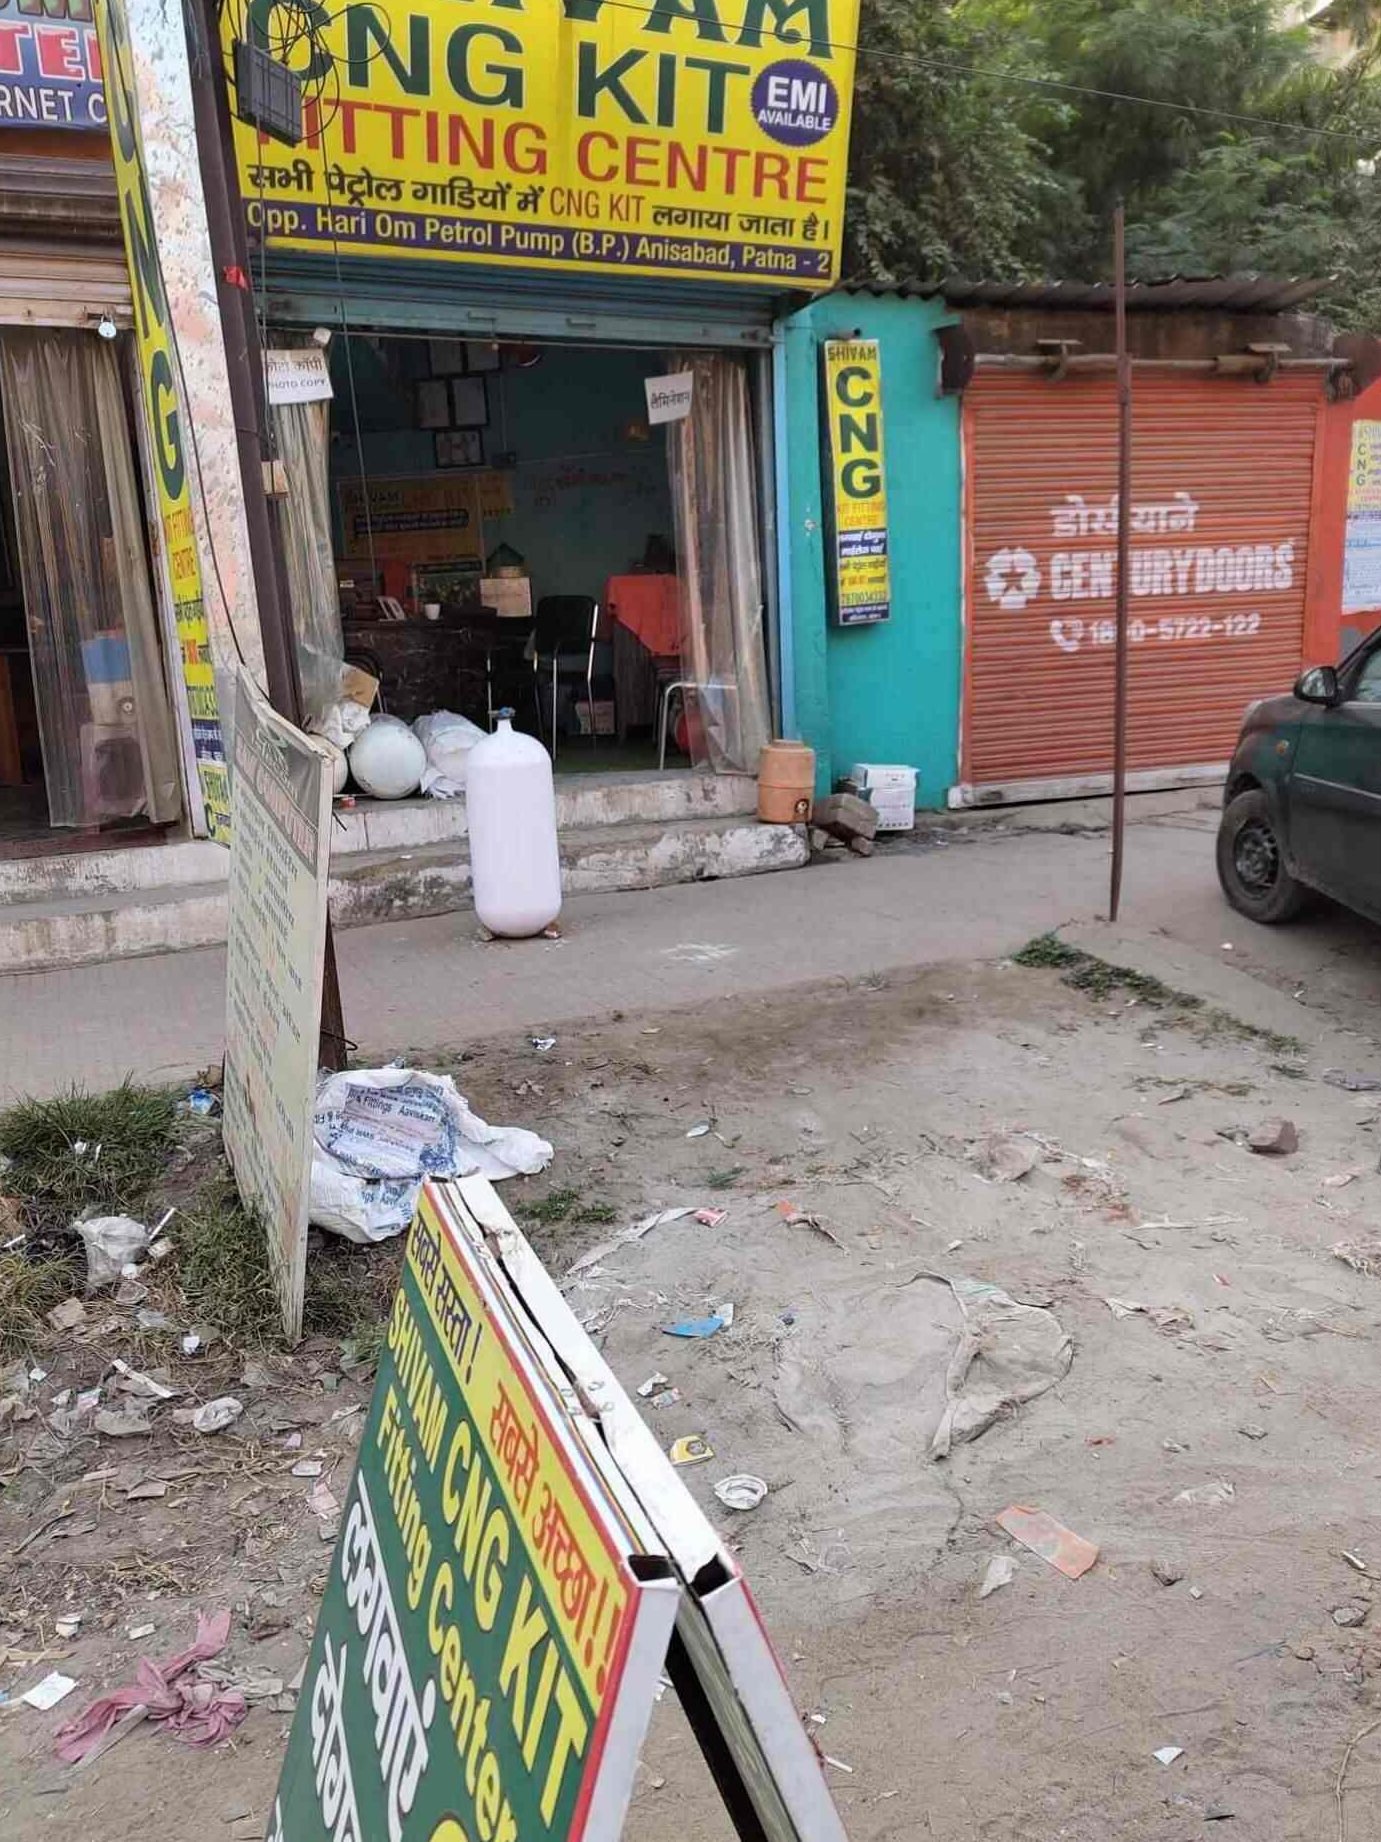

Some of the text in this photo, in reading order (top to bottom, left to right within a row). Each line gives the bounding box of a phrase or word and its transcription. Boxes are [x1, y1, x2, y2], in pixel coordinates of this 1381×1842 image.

[577, 40, 751, 134] KIT
[757, 108, 833, 131] AVAILABLE
[767, 75, 828, 114] EMI
[246, 158, 314, 192] सभी
[324, 163, 405, 208] पेट्रोल
[516, 185, 545, 214] में
[550, 186, 600, 219] CNG
[608, 193, 646, 223] KIT
[651, 205, 732, 232] लगाया
[738, 213, 796, 237] जाता
[258, 96, 830, 205] ITTING CENTRE
[247, 202, 307, 234] Opp.
[316, 207, 367, 235] Hari
[375, 213, 416, 240] Om
[425, 218, 492, 247] Petrol
[501, 225, 565, 256] Pump
[636, 236, 737, 269] Anisabad,
[743, 246, 797, 271] Patna
[835, 366, 882, 499] CNG
[405, 1206, 443, 1296] सबसे
[435, 1261, 473, 1367] सस्ता
[489, 1379, 540, 1518] सबसे
[376, 1383, 432, 1612] Fitting
[387, 1287, 449, 1475] SHIVAM
[442, 1418, 510, 1632] CNG
[499, 1574, 589, 1830] KIT
